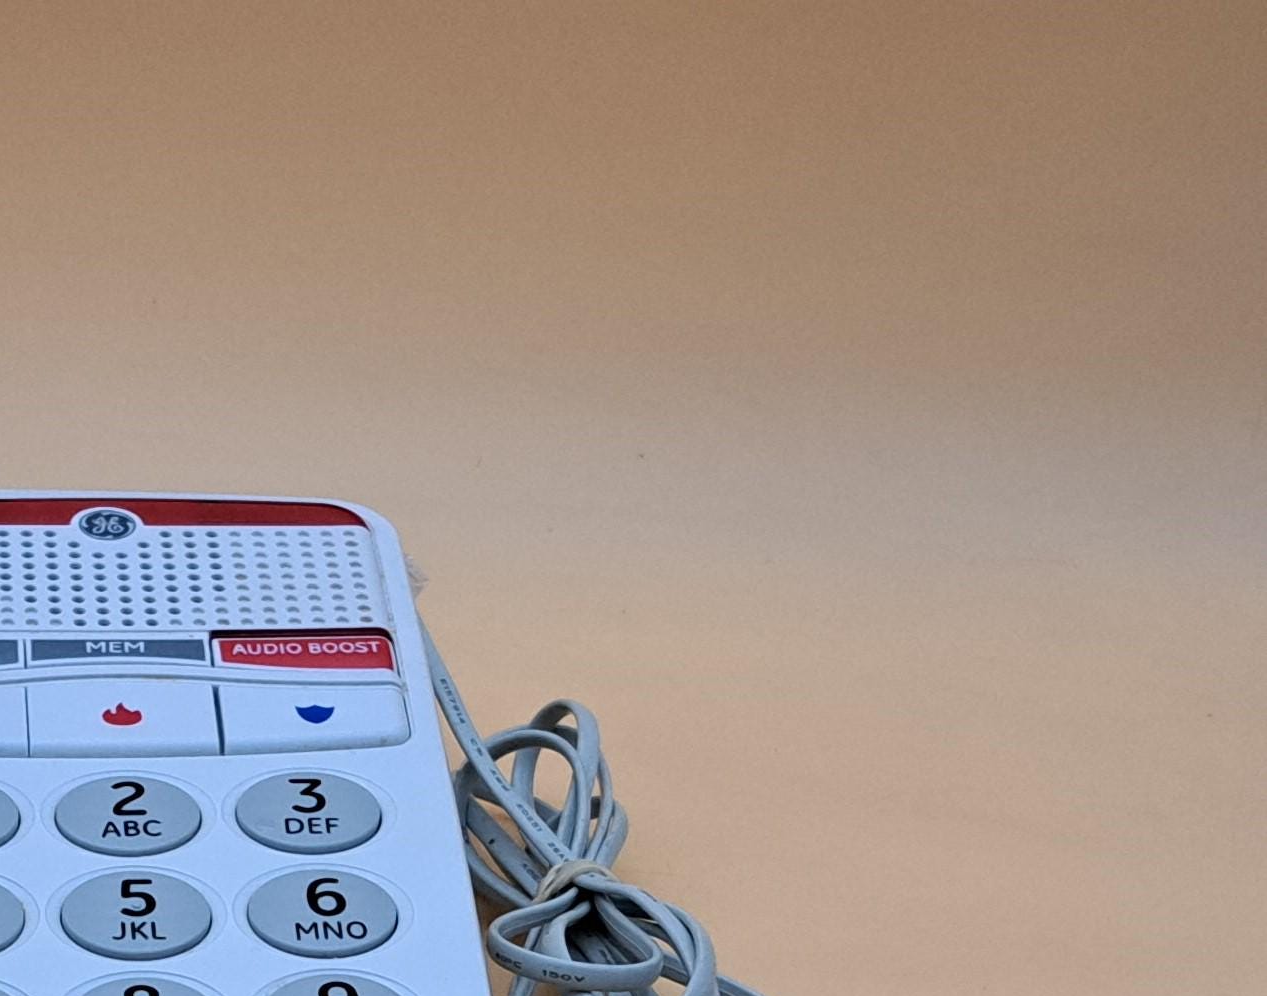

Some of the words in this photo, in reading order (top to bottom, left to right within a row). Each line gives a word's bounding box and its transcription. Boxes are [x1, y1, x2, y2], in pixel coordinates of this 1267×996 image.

[85, 641, 146, 654] MEM
[232, 642, 302, 656] AUDIO
[307, 641, 381, 654] BOOST
[111, 781, 147, 816] 2
[289, 778, 327, 814] 3
[101, 818, 162, 839] ABC
[284, 817, 340, 835] DEF
[120, 879, 157, 917] 5
[306, 878, 347, 917] 6
[112, 921, 167, 941] JKL
[295, 921, 368, 941] MNO
